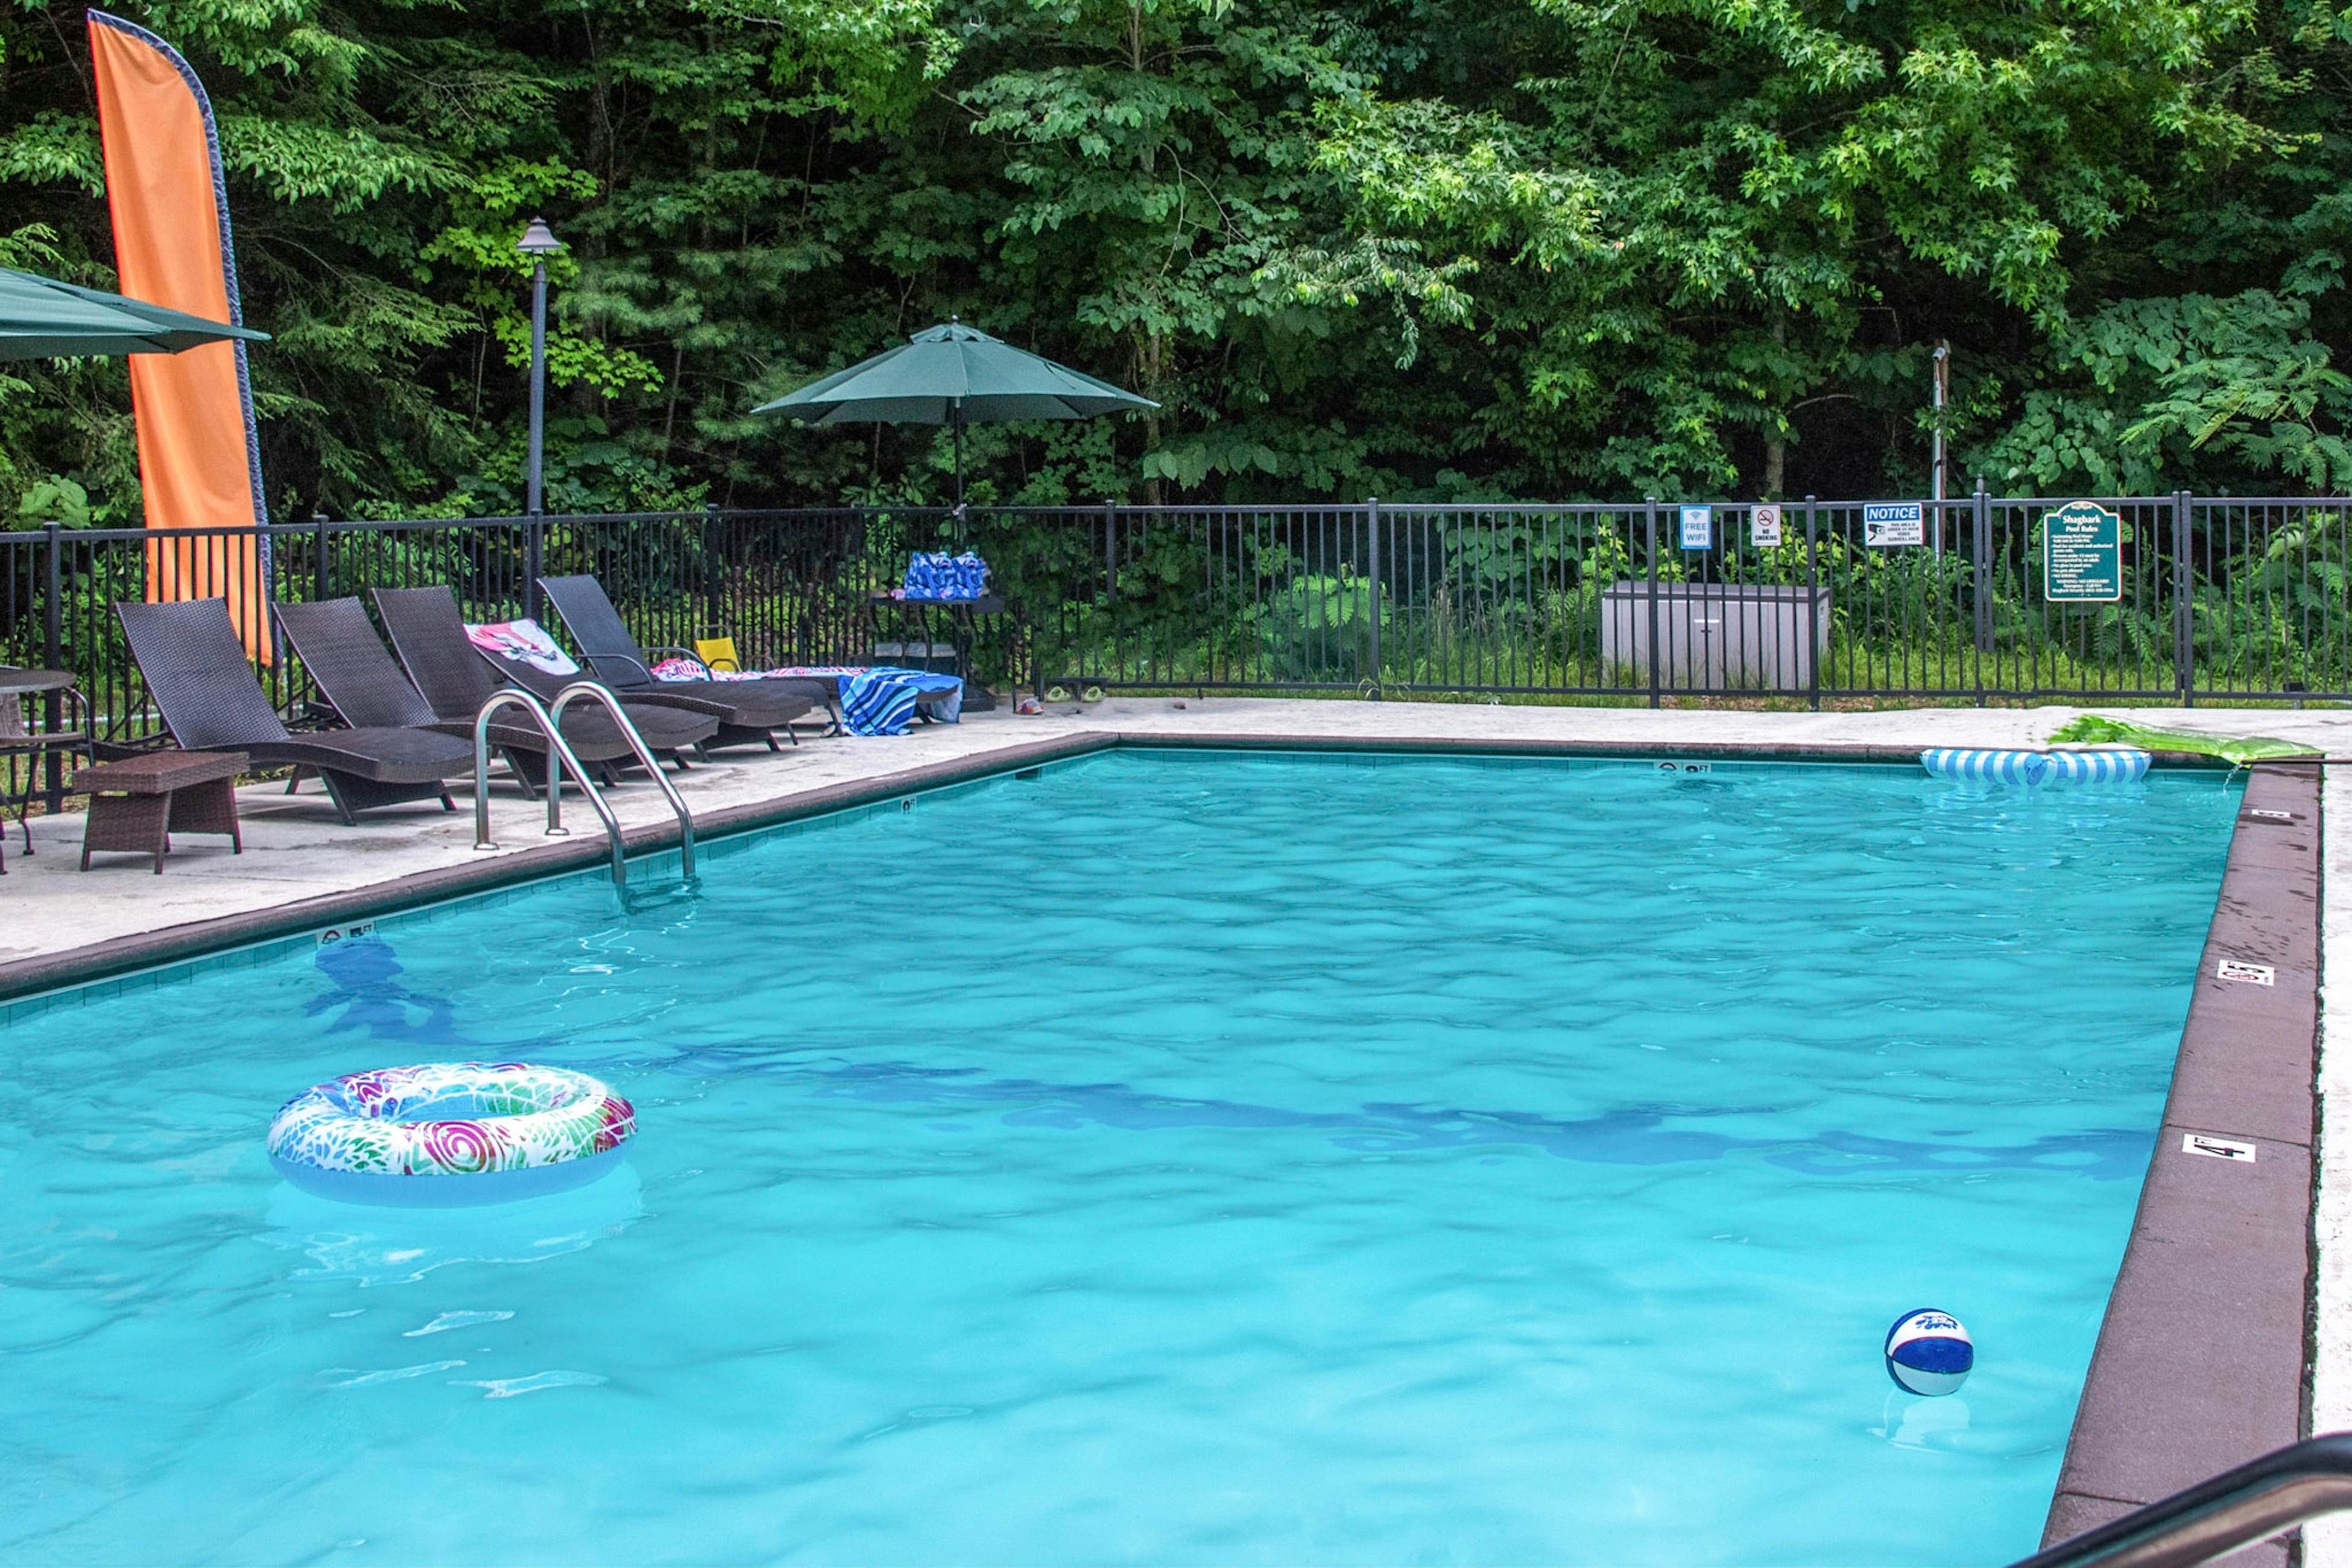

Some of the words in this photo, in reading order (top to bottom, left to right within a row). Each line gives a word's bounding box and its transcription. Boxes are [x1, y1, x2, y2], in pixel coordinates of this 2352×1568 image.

[1868, 507, 1917, 519] NOTICE
[2063, 514, 2101, 526] Shagbark
[2194, 1144, 2245, 1157] 4
